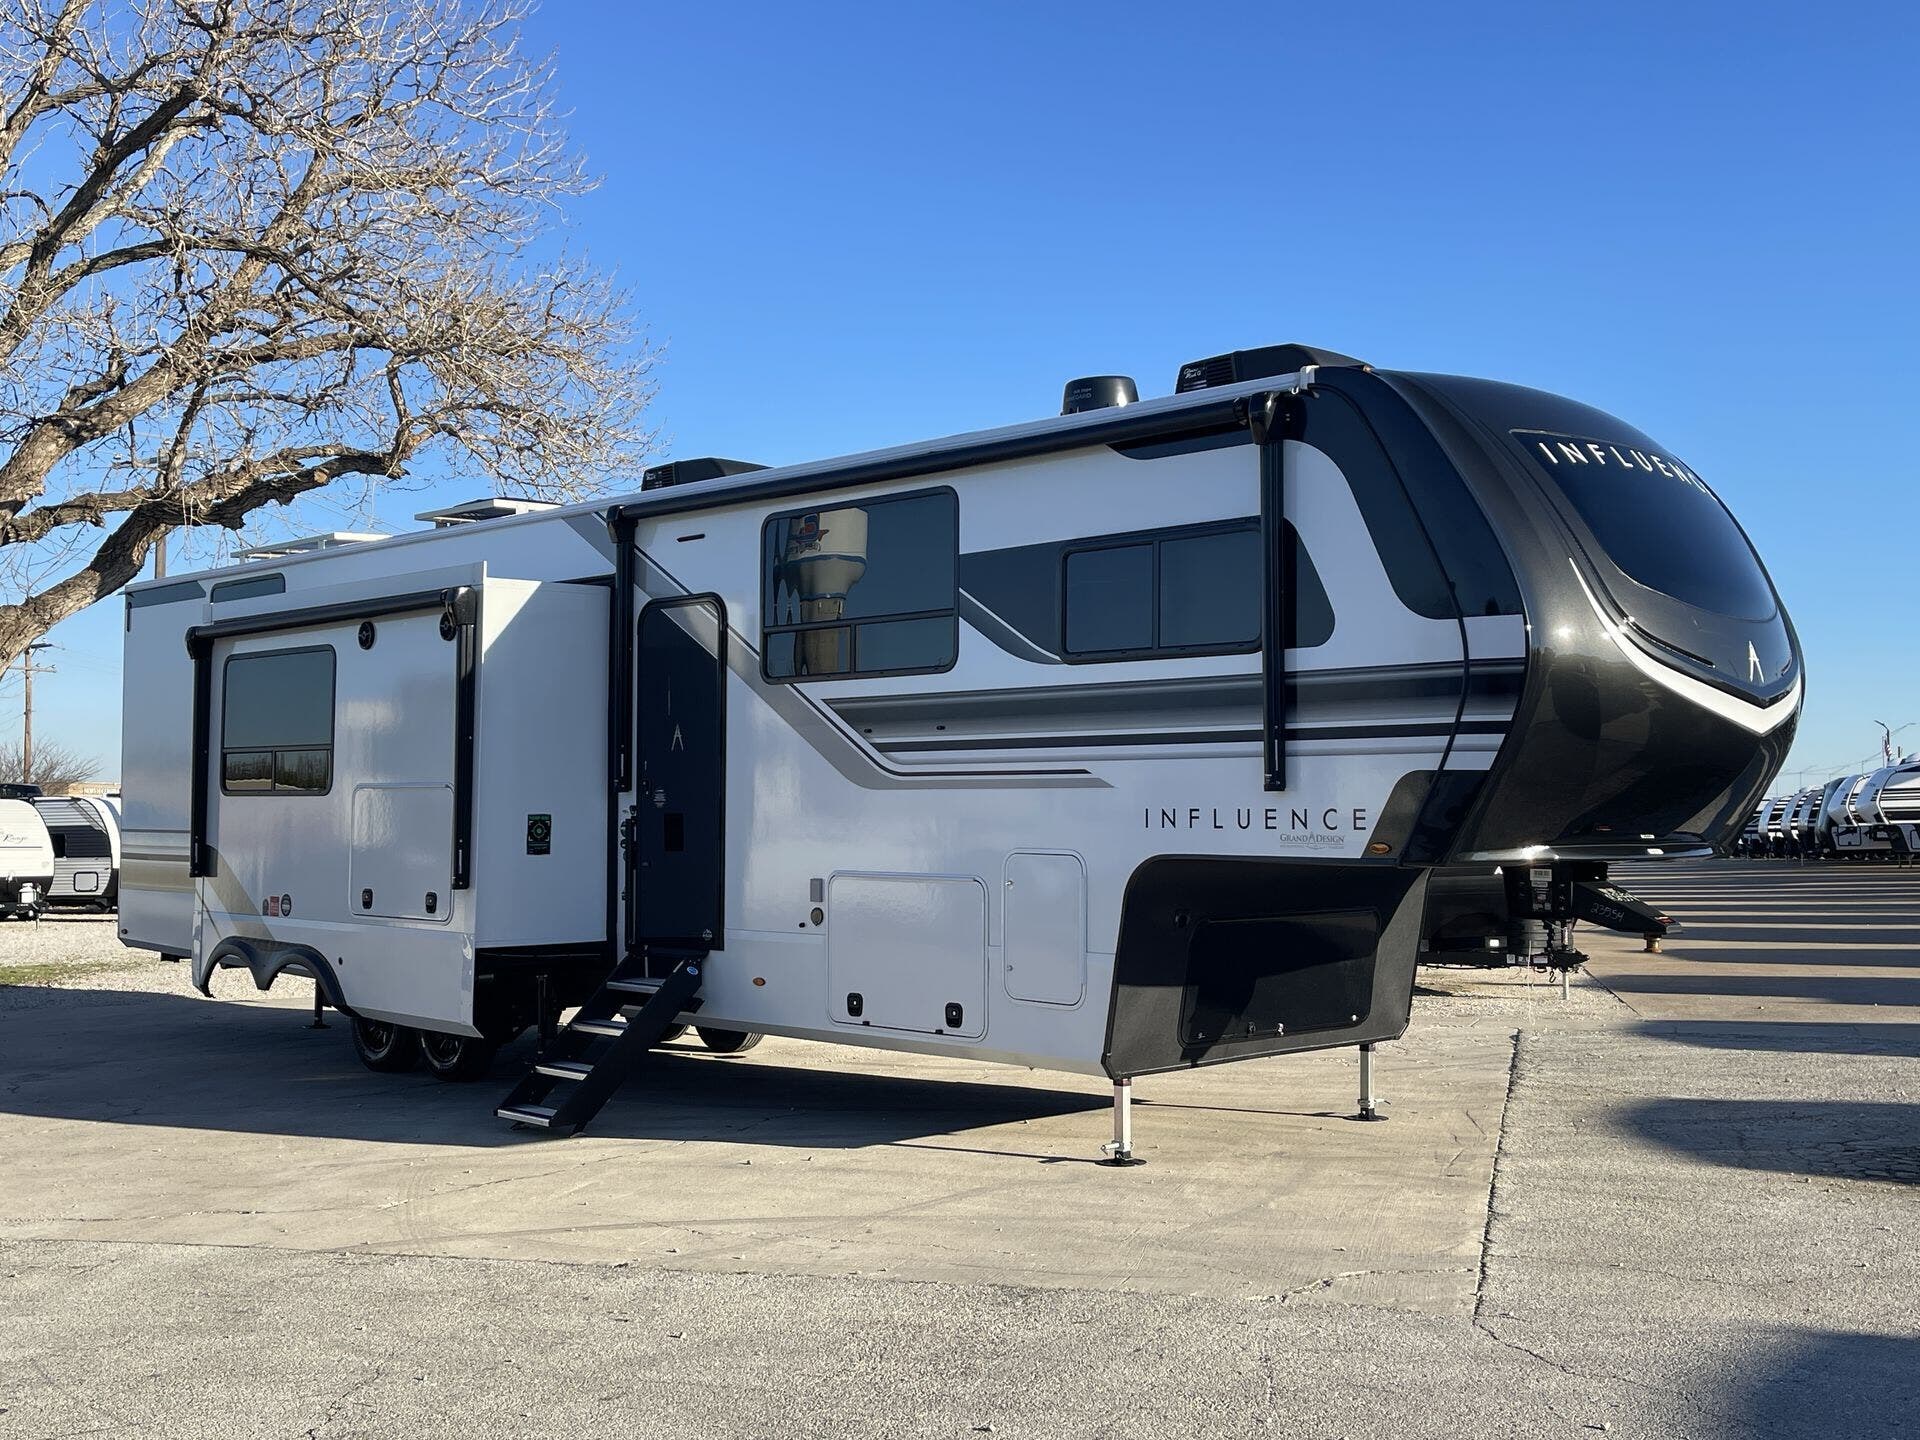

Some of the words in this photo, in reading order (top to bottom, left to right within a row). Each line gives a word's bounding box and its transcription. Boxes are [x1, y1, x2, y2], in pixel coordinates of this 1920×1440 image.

[1144, 808, 1367, 831] INFLUENCE
[1279, 833, 1308, 843] GRAND
[1316, 833, 1345, 843] DESIGN
